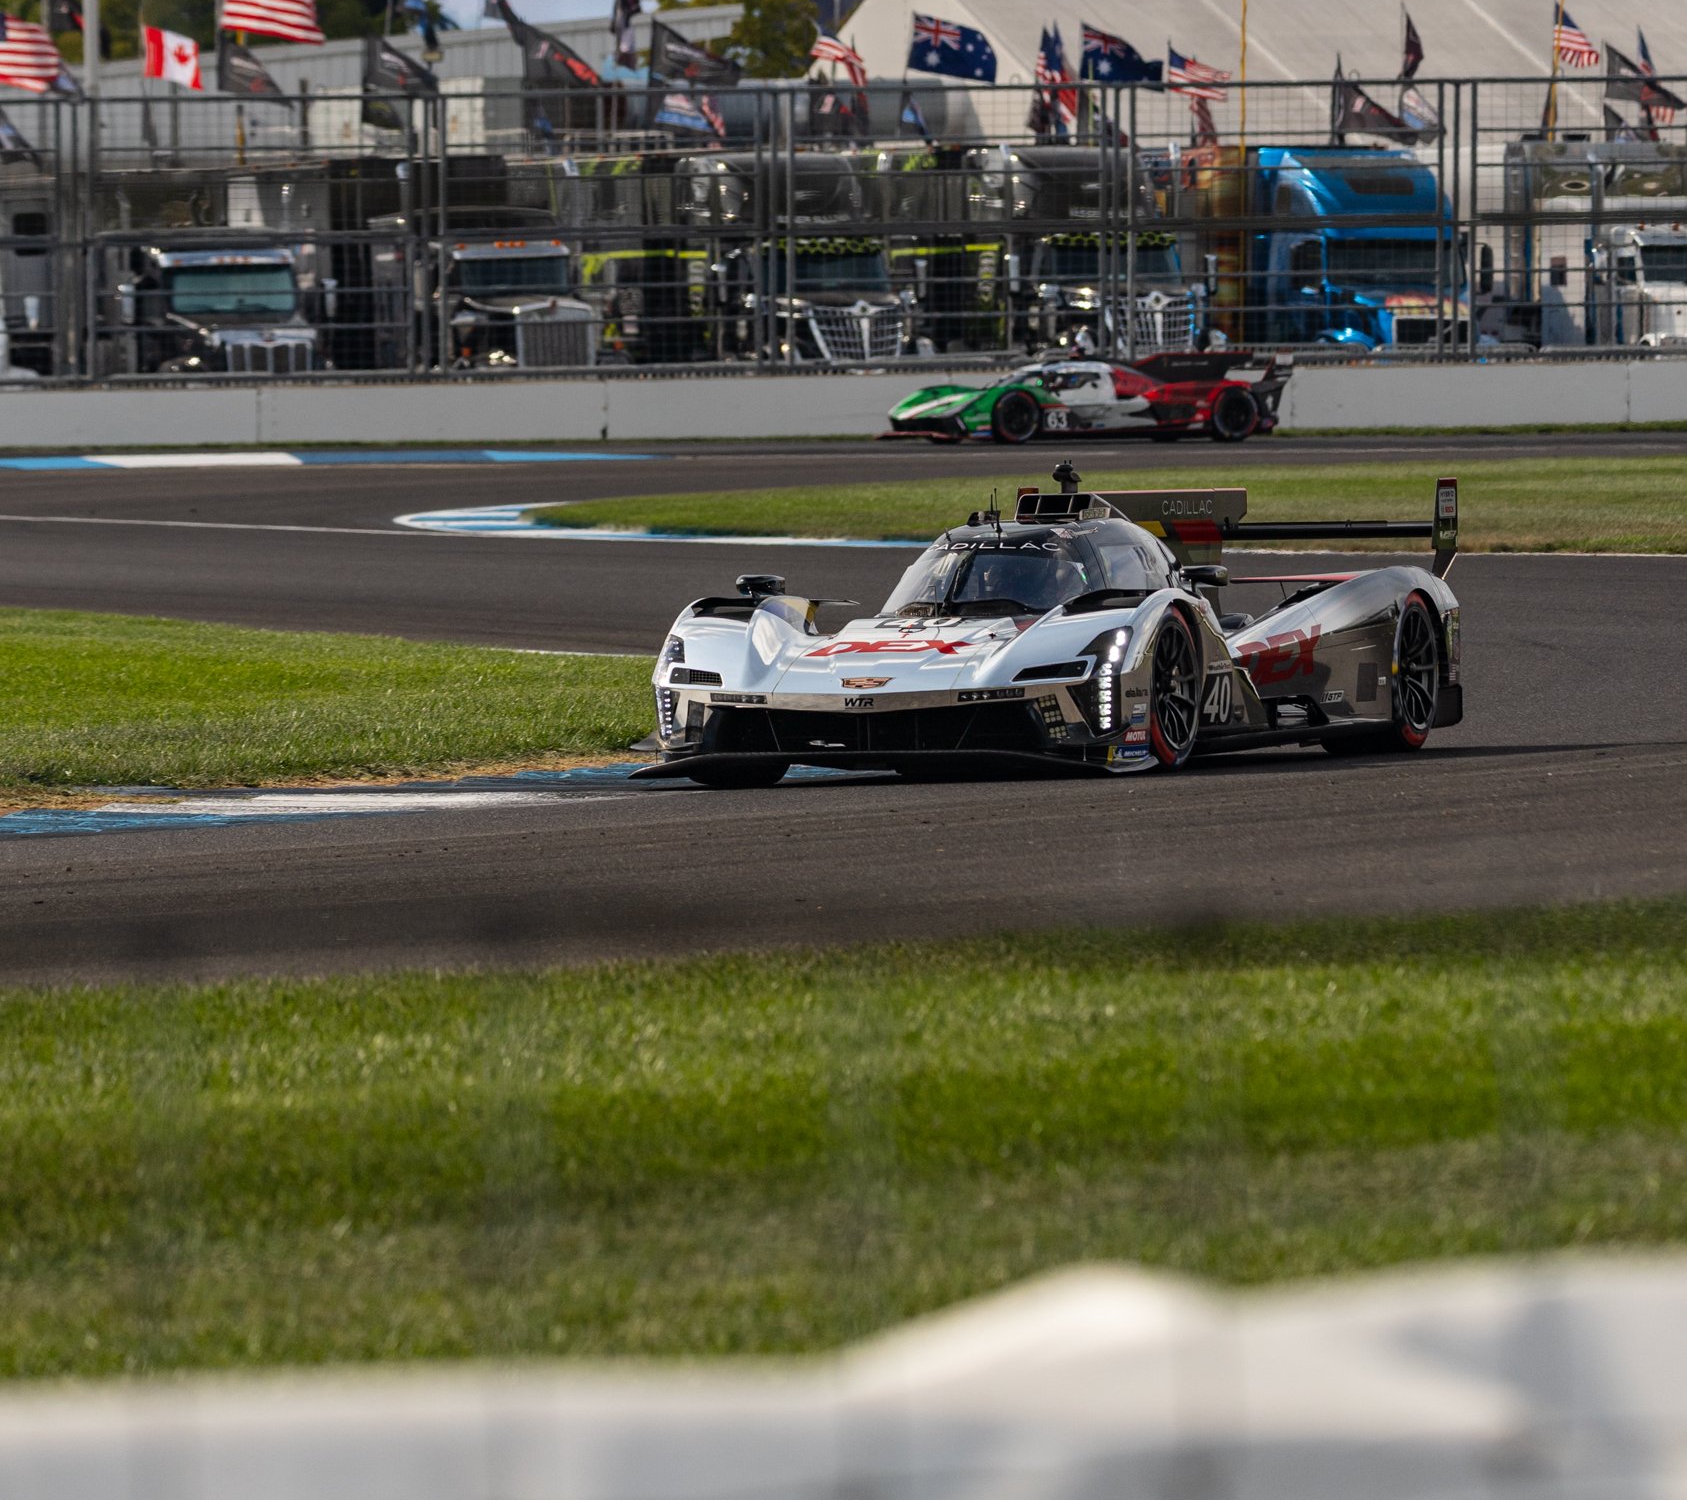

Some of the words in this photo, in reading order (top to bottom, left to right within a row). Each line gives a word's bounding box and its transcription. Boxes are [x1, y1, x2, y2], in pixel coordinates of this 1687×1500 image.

[1047, 412, 1068, 428] 63
[1161, 500, 1213, 515] CADILLAC
[927, 540, 1061, 552] CADILLAC
[883, 617, 962, 628] 40
[805, 640, 975, 656] DEX
[1235, 623, 1322, 686] DEX
[844, 697, 874, 708] WTR
[1203, 674, 1232, 724] 40
[1125, 731, 1146, 742] MOTUL
